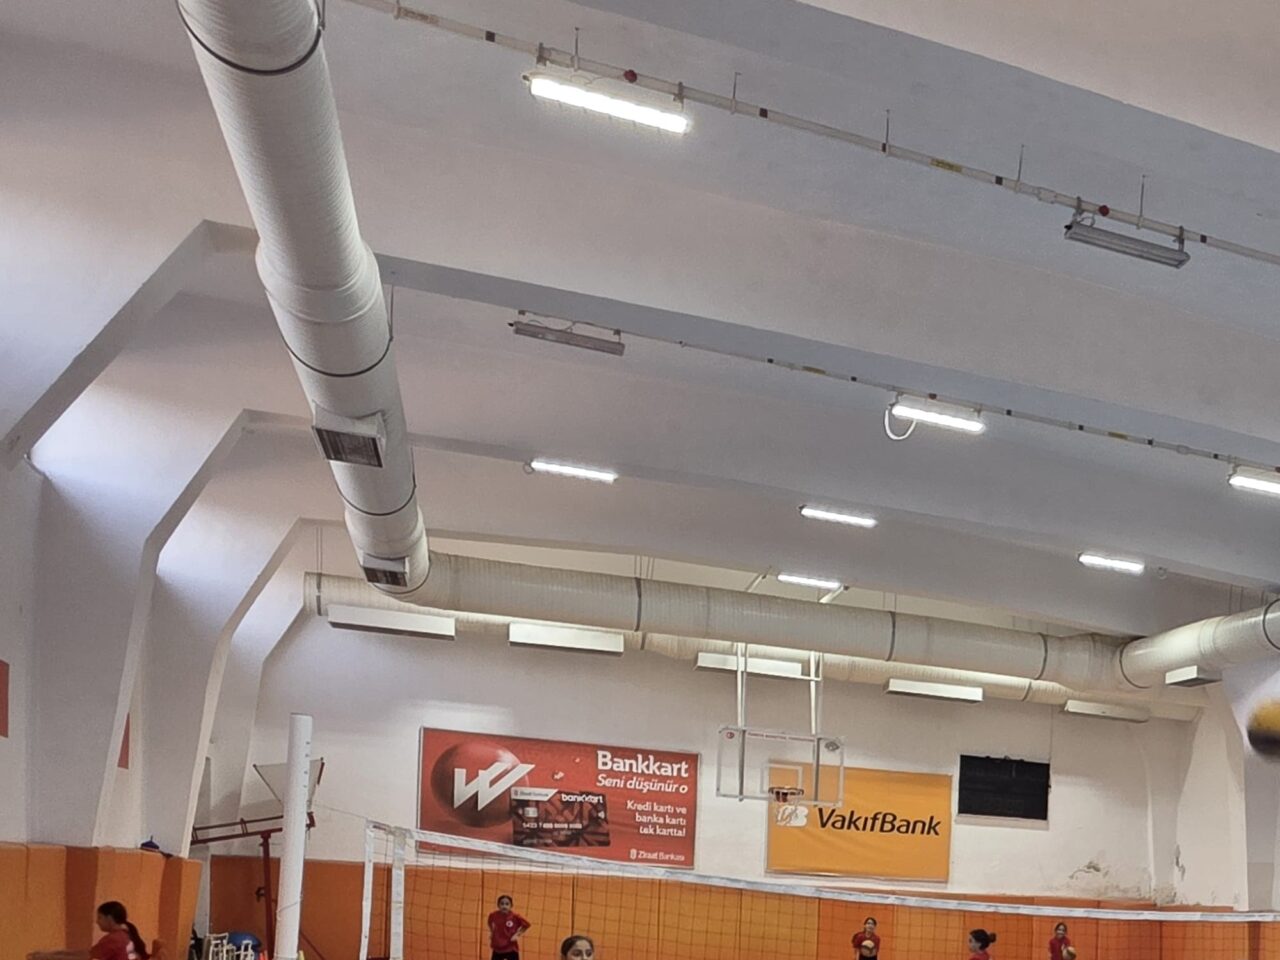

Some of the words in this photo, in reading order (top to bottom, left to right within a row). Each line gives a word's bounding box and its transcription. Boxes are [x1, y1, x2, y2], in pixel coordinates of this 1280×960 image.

[597, 750, 688, 777] Bankkart
[596, 774, 624, 788] Seni
[626, 777, 679, 793] düşünür
[679, 784, 688, 794] o
[627, 800, 652, 811] Kredi
[653, 802, 674, 813] kartı
[635, 812, 664, 823] banka
[666, 814, 686, 825] kartı
[818, 807, 941, 836] VakıfBank
[639, 825, 655, 834] tek
